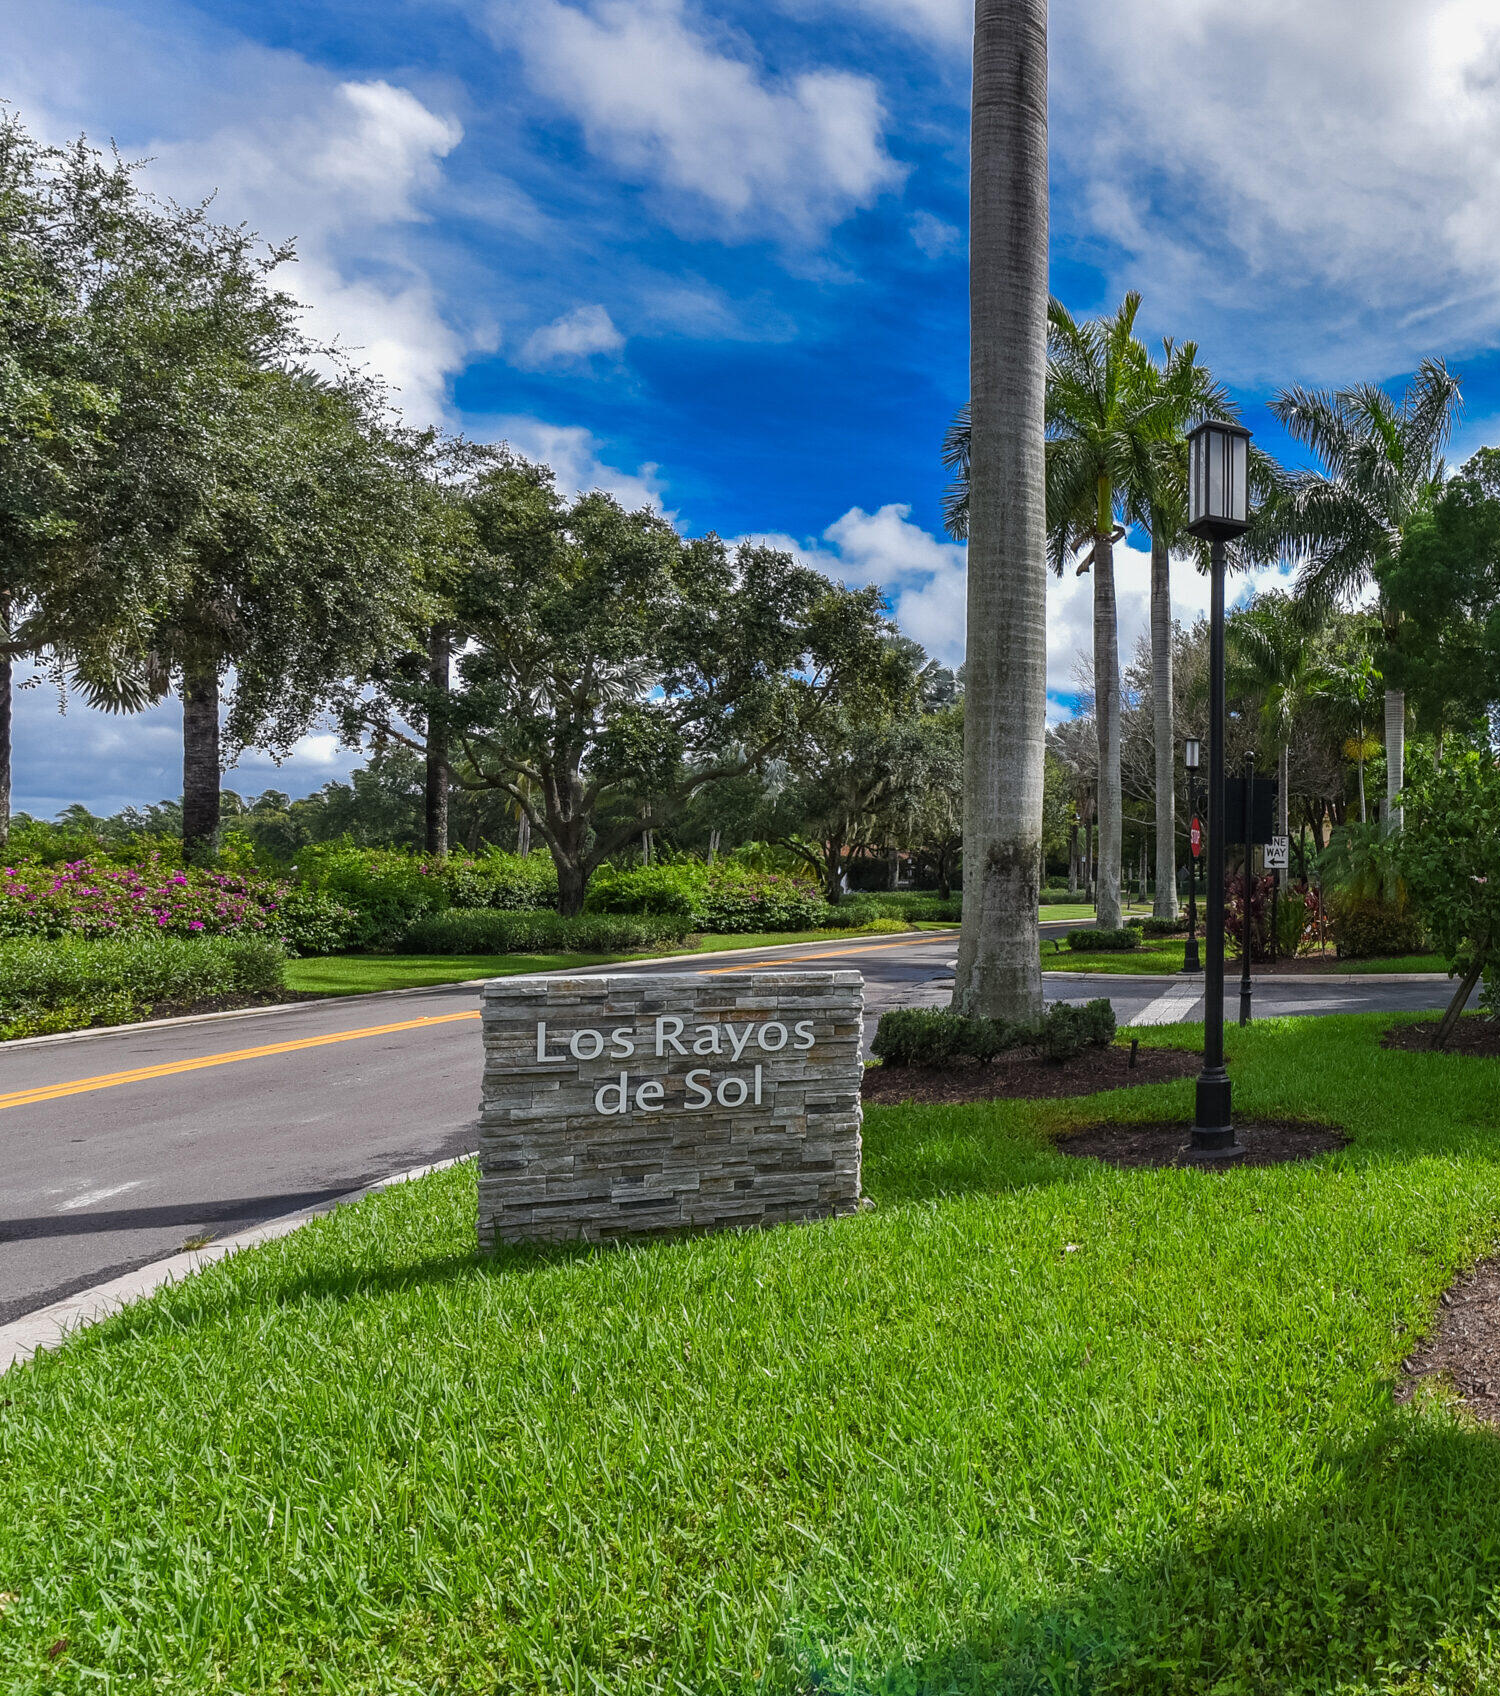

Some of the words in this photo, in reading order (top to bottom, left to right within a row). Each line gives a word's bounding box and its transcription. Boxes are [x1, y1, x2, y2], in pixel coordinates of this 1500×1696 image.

[1190, 829, 1200, 844] STOP
[1266, 837, 1286, 847] NE
[1266, 848, 1286, 857] WAY
[536, 1021, 635, 1063] Los
[655, 1015, 816, 1062] Rayos
[595, 1070, 665, 1115] de
[684, 1064, 762, 1110] Sol
